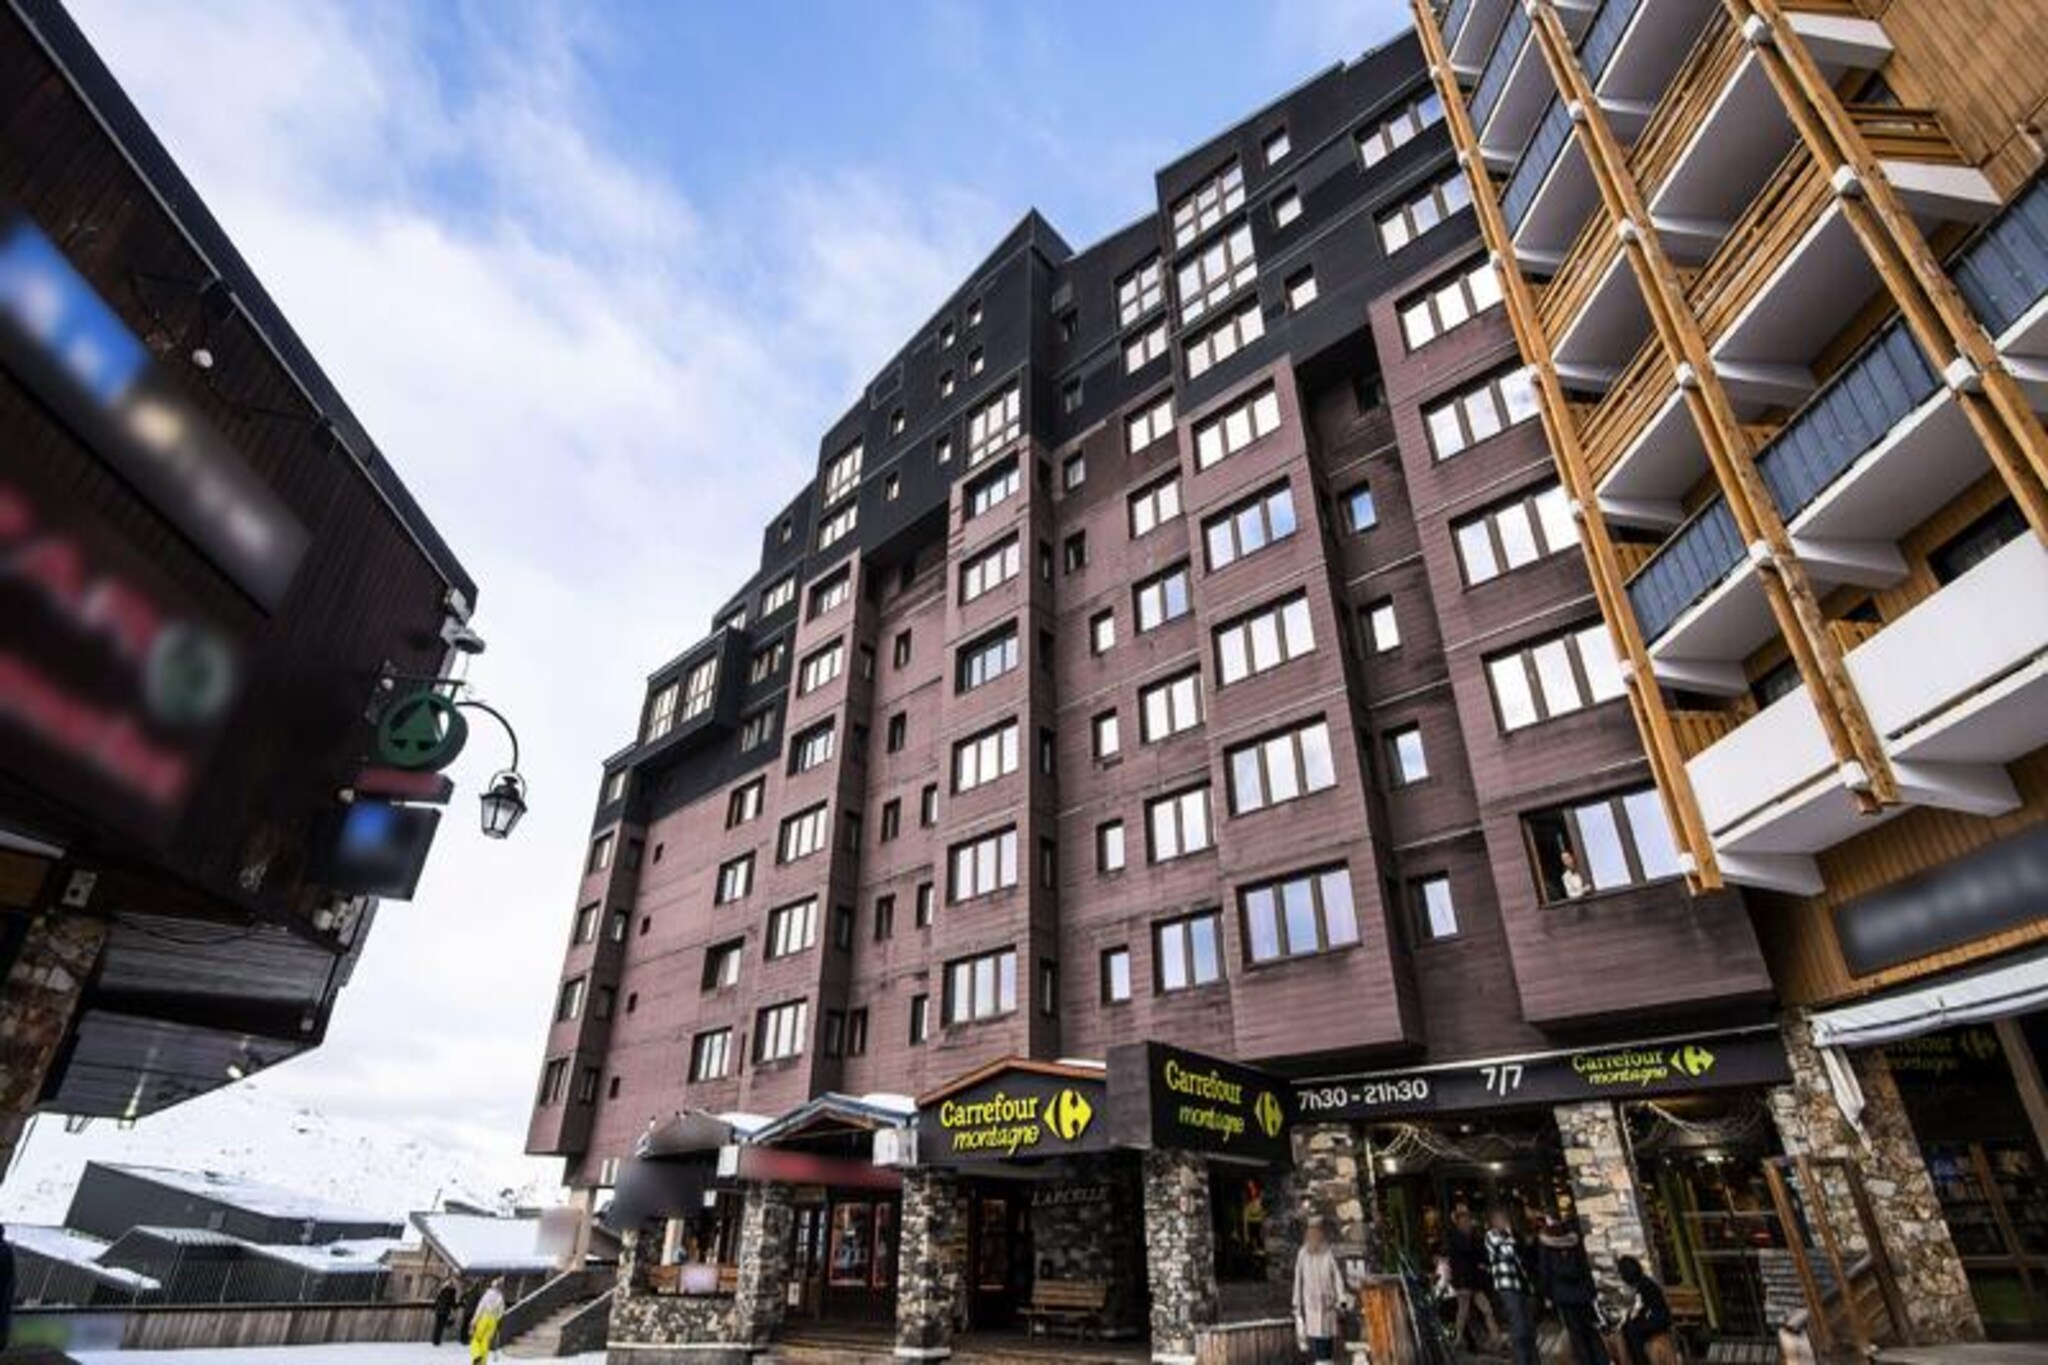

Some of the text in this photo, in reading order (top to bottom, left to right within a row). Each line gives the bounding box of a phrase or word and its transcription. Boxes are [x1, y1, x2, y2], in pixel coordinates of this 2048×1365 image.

[1572, 1050, 1663, 1073] Carrefour
[1589, 1066, 1668, 1088] montagne
[1164, 1059, 1242, 1105] Carrefour
[1297, 1087, 1348, 1111] 7h30
[1363, 1079, 1429, 1104] 21h30
[1479, 1065, 1523, 1096] 7/7
[940, 1092, 1039, 1127] Carrefour
[1179, 1105, 1245, 1143] montagne
[953, 1124, 1040, 1156] montagne
